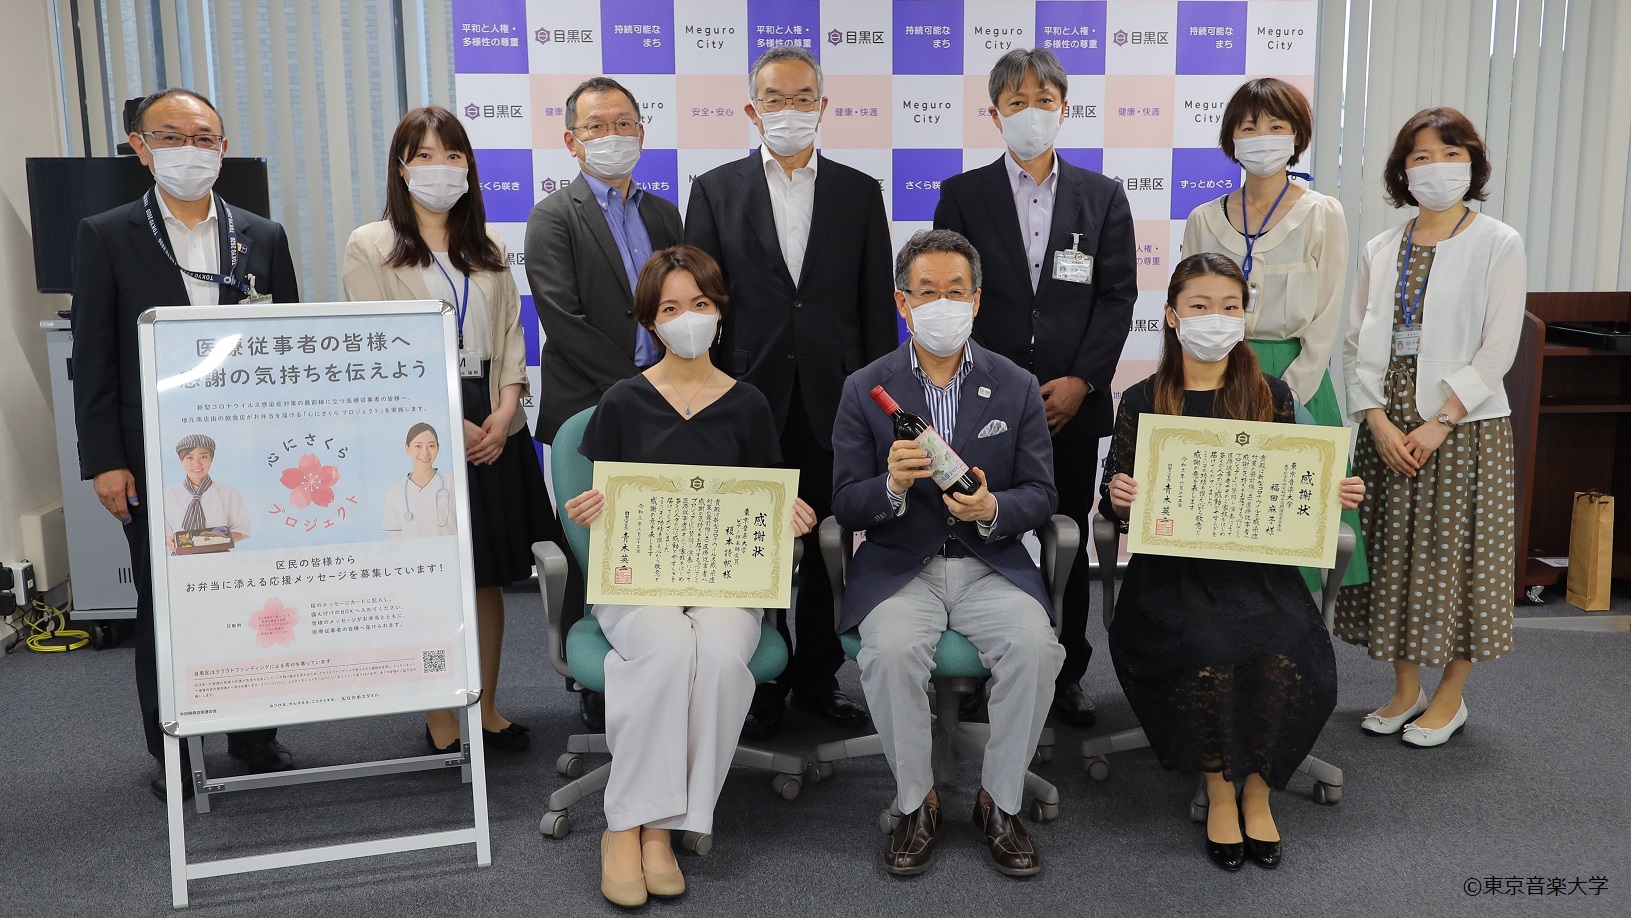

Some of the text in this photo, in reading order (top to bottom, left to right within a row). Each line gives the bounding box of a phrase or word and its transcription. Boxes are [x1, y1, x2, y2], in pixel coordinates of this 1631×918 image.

[614, 24, 661, 35] 持続可能な
[685, 25, 735, 37] Meguro
[905, 25, 951, 36] 持続可能な
[974, 26, 1023, 38] Meguro
[1189, 26, 1233, 36] 持続可能な
[1257, 27, 1304, 38] Meguro
[554, 29, 594, 44] 目黒区
[643, 37, 661, 48] まち
[846, 30, 885, 44] 目黒区
[1131, 31, 1169, 45] 目黒区
[461, 37, 519, 49] 多様性の尊重
[696, 37, 724, 50] City
[932, 38, 951, 49] まち
[985, 38, 1012, 51] City
[1043, 39, 1098, 51] 多様性の尊重
[1215, 38, 1233, 49] まち
[1267, 39, 1293, 51] City
[483, 104, 523, 119] 目黒区
[636, 101, 663, 110] uro
[903, 100, 952, 112] Meguro
[1118, 107, 1160, 116] 健康・快適
[1184, 100, 1223, 111] Megur
[691, 108, 734, 117] 安全・安心
[835, 107, 878, 117] 健康・快適
[913, 113, 941, 125] City
[1193, 113, 1220, 124] City
[905, 180, 941, 190] さくら咲
[1127, 178, 1164, 191] 目黒区
[1180, 179, 1233, 189] ずっとめぐろ
[1130, 319, 1160, 332] 黒区
[1297, 470, 1316, 516] 感謝状
[752, 512, 767, 558] 感謝状
[275, 554, 356, 570] 区民の皆様から
